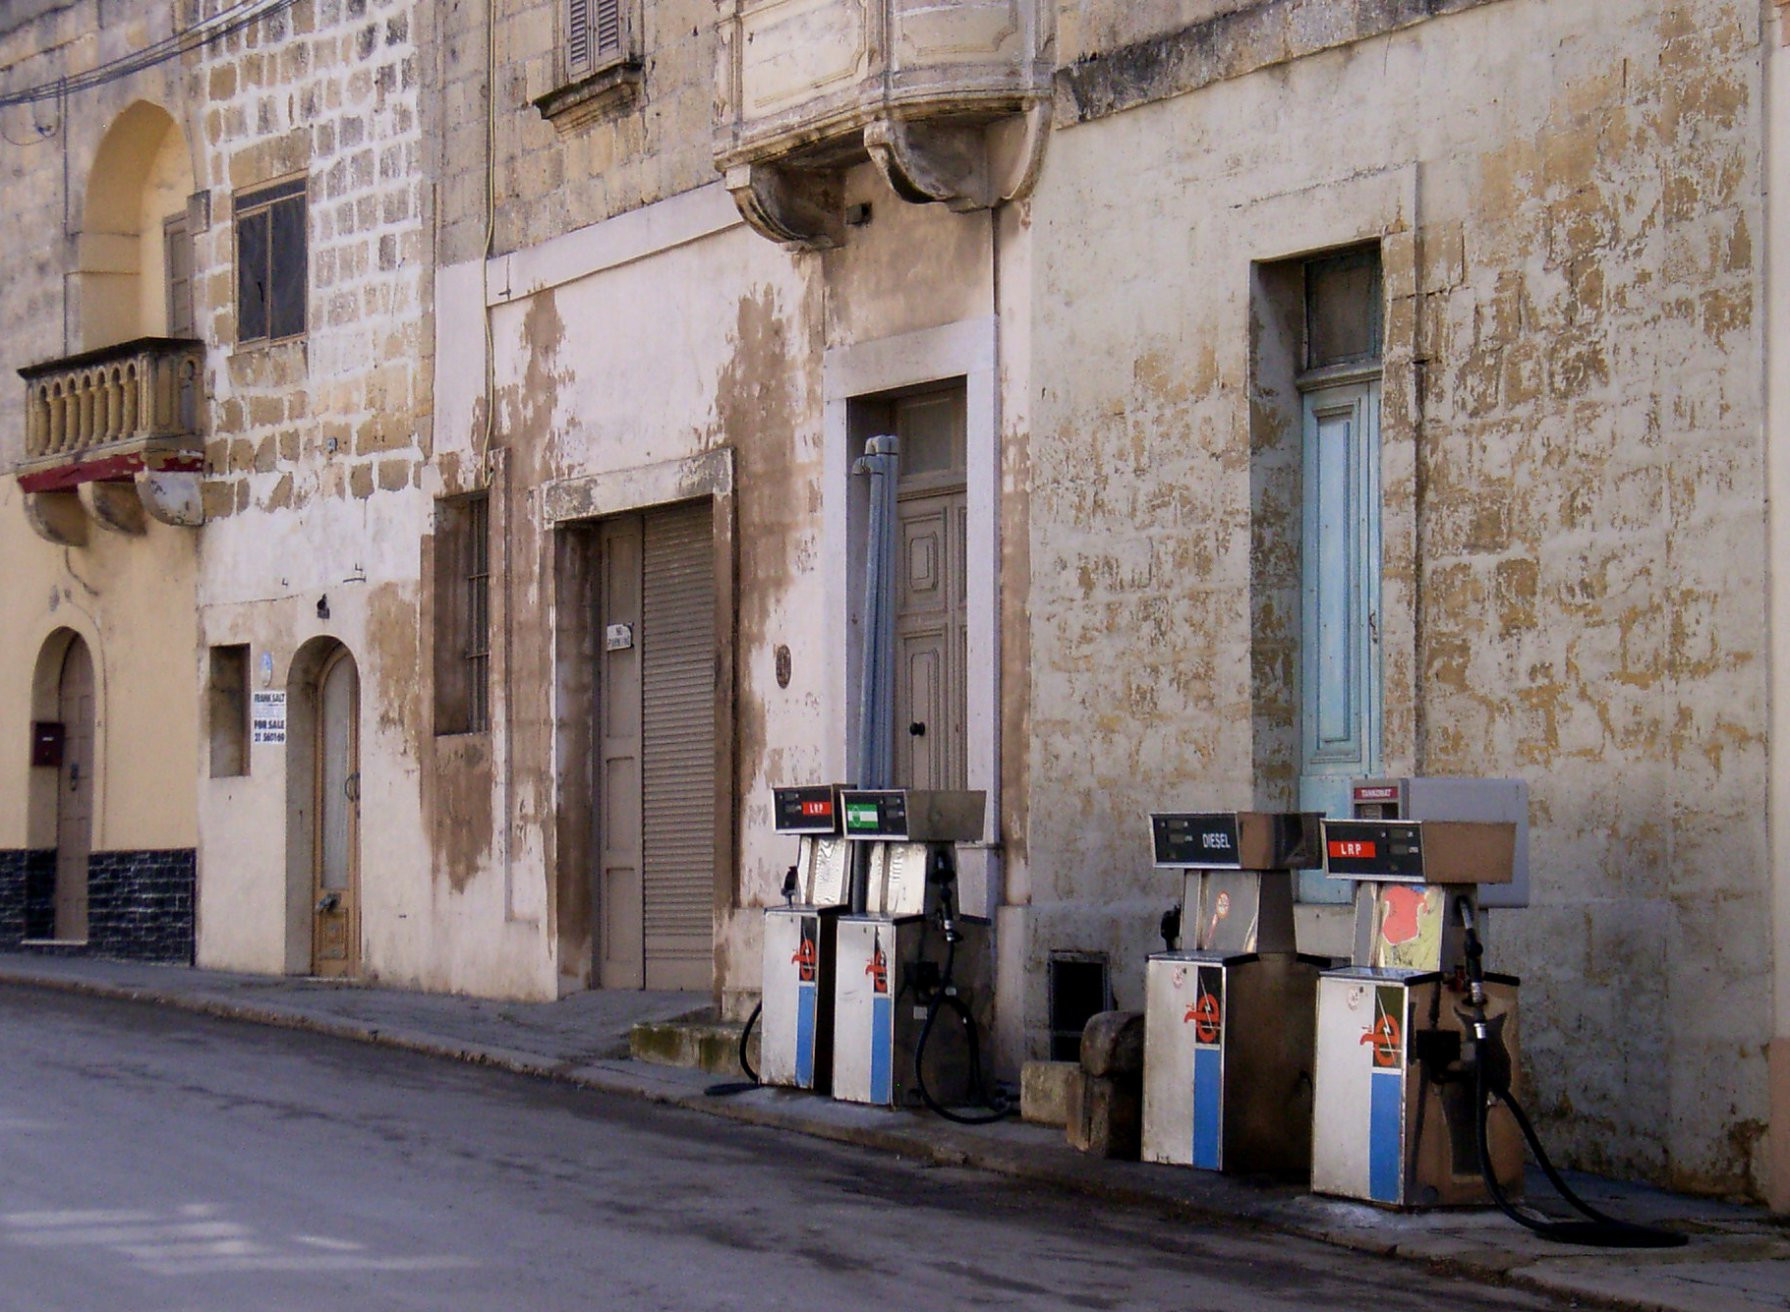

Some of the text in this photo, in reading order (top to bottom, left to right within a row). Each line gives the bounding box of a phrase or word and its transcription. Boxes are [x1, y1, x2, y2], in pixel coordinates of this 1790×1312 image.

[254, 719, 284, 729] FOR SALE
[809, 802, 823, 814] LRP
[1202, 833, 1231, 849] DIESEL
[1340, 843, 1362, 855] LRP
